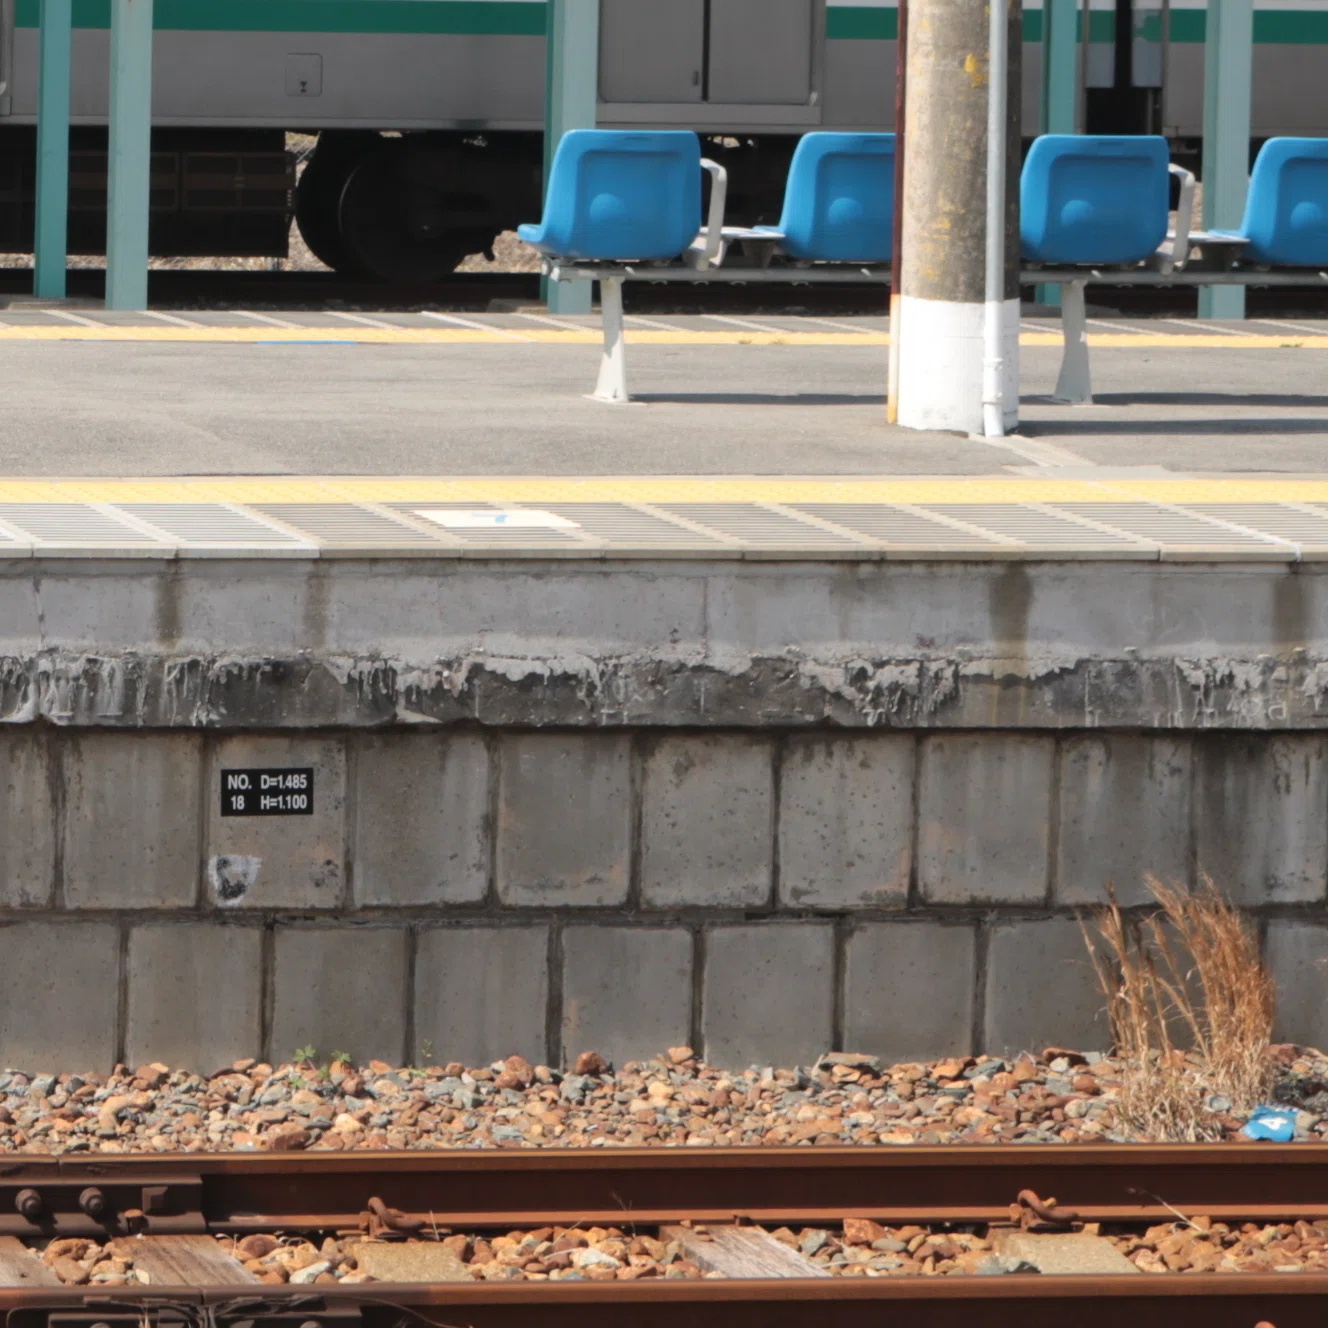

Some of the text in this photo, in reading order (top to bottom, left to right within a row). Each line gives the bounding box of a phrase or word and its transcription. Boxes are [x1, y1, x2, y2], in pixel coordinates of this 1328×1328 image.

[228, 774, 252, 790] NO.
[230, 794, 308, 810] 18 H=1.100
